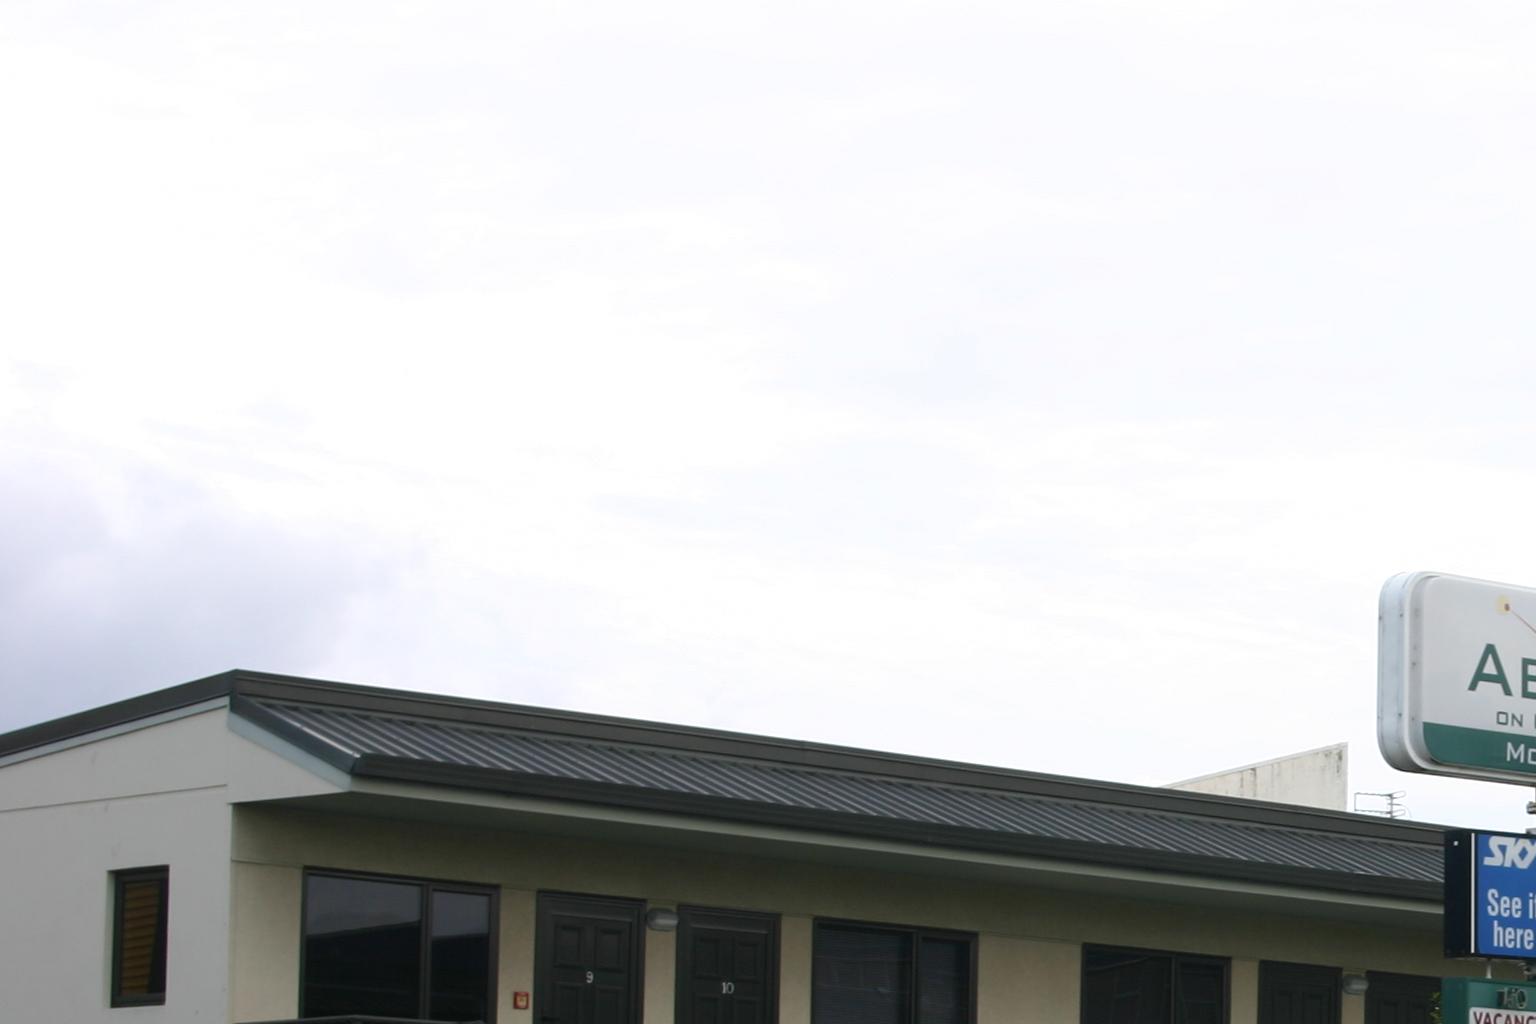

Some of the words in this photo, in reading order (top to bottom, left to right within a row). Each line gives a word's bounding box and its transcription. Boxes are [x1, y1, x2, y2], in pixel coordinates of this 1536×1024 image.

[1496, 711, 1524, 728] ON
[1487, 888, 1522, 919] See
[1493, 920, 1535, 950] here
[585, 971, 594, 984] 9
[722, 982, 735, 994] 10
